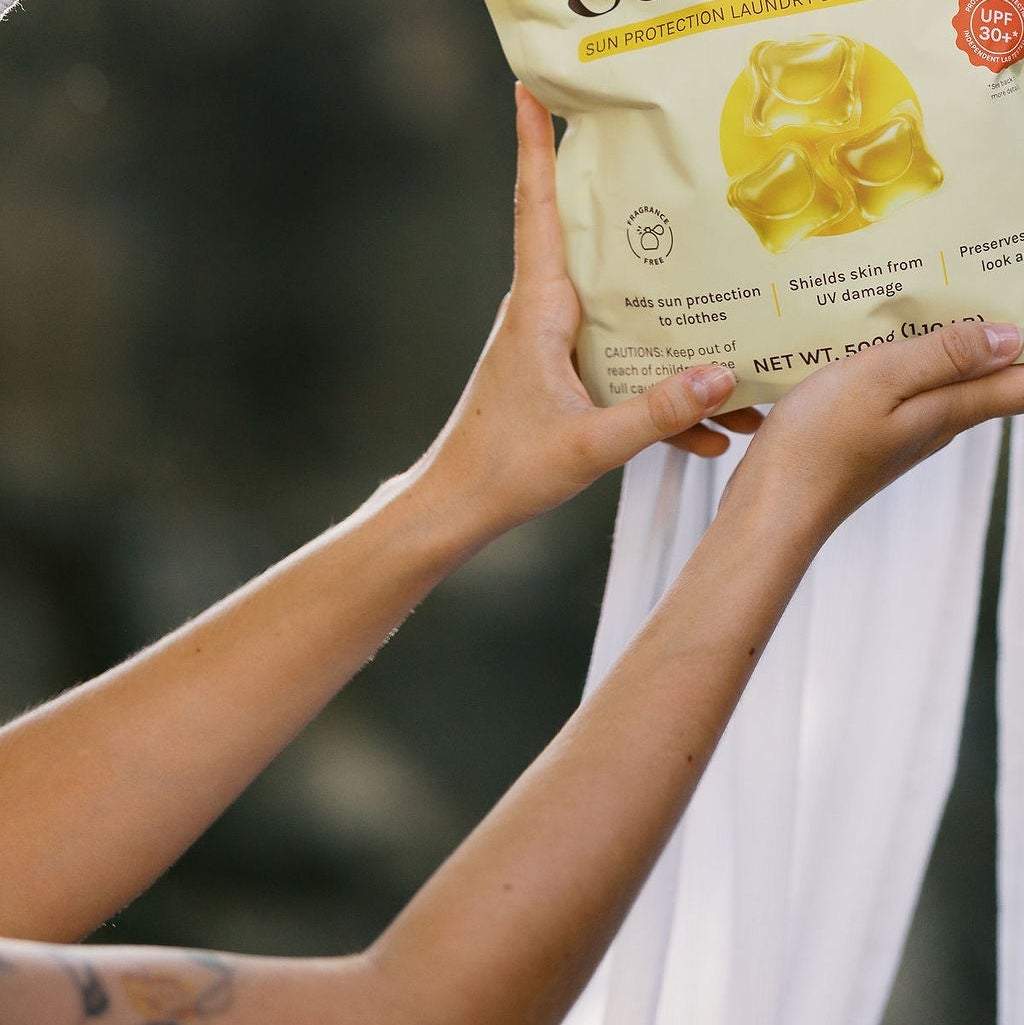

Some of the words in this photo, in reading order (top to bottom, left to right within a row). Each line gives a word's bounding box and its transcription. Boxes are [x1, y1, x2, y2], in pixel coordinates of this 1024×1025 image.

[980, 8, 1013, 26] UPF
[585, 36, 620, 57] SUN
[624, 6, 726, 47] PROTECTION
[963, 29, 1001, 64] INDEPENDENT
[626, 205, 670, 226] FRAGRANCE
[643, 256, 665, 266] FREE
[980, 254, 1012, 272] look
[788, 271, 847, 292] Shields
[849, 261, 884, 281] skin
[886, 256, 924, 274] from
[623, 294, 655, 309] Adds
[657, 295, 683, 309] sun
[686, 284, 762, 309] protection
[815, 291, 838, 306] UV
[841, 280, 904, 302] damage
[658, 314, 673, 327] to
[675, 309, 728, 326] clothes
[604, 345, 664, 359] CAUTIONS:
[665, 347, 696, 360] Keep
[697, 343, 721, 357] out
[723, 339, 738, 352] of
[752, 353, 794, 374] NET
[798, 346, 841, 366] WT.
[606, 364, 640, 377] reach
[641, 363, 653, 377] of
[655, 363, 692, 376] child
[711, 360, 736, 370] ee
[609, 382, 629, 395] full
